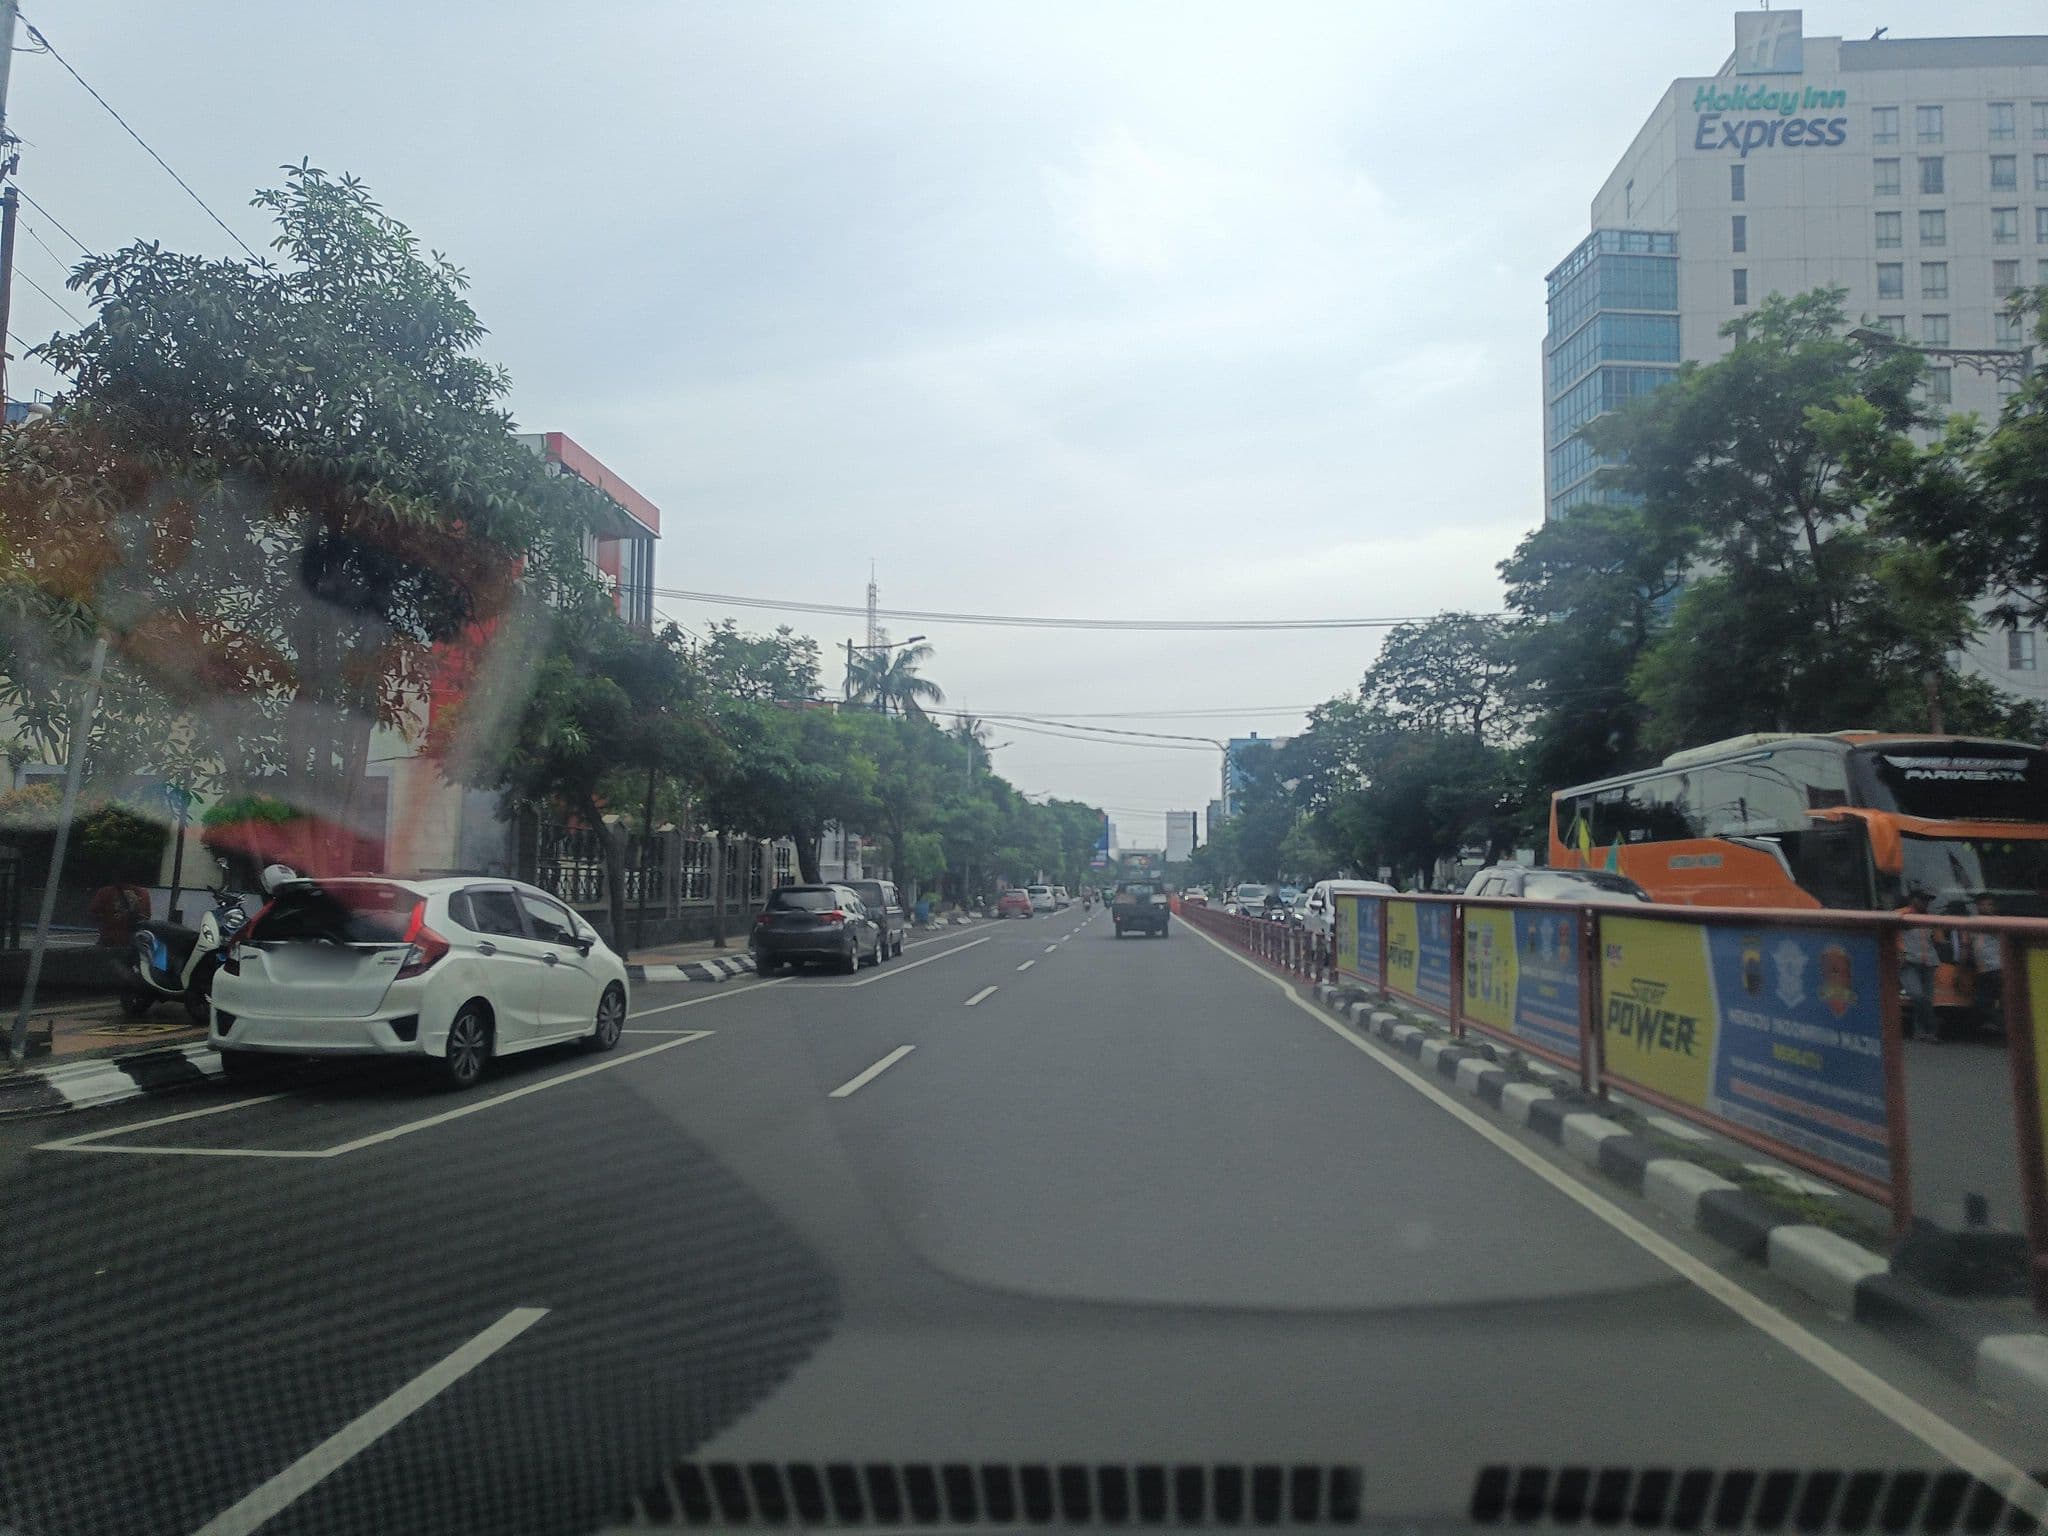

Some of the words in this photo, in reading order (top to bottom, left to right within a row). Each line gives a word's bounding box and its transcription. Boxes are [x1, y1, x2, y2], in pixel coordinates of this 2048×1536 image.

[1694, 83, 1799, 116] Holiday
[1803, 86, 1847, 109] Inn
[1694, 112, 1848, 158] Express
[1607, 997, 1699, 1056] POWER
